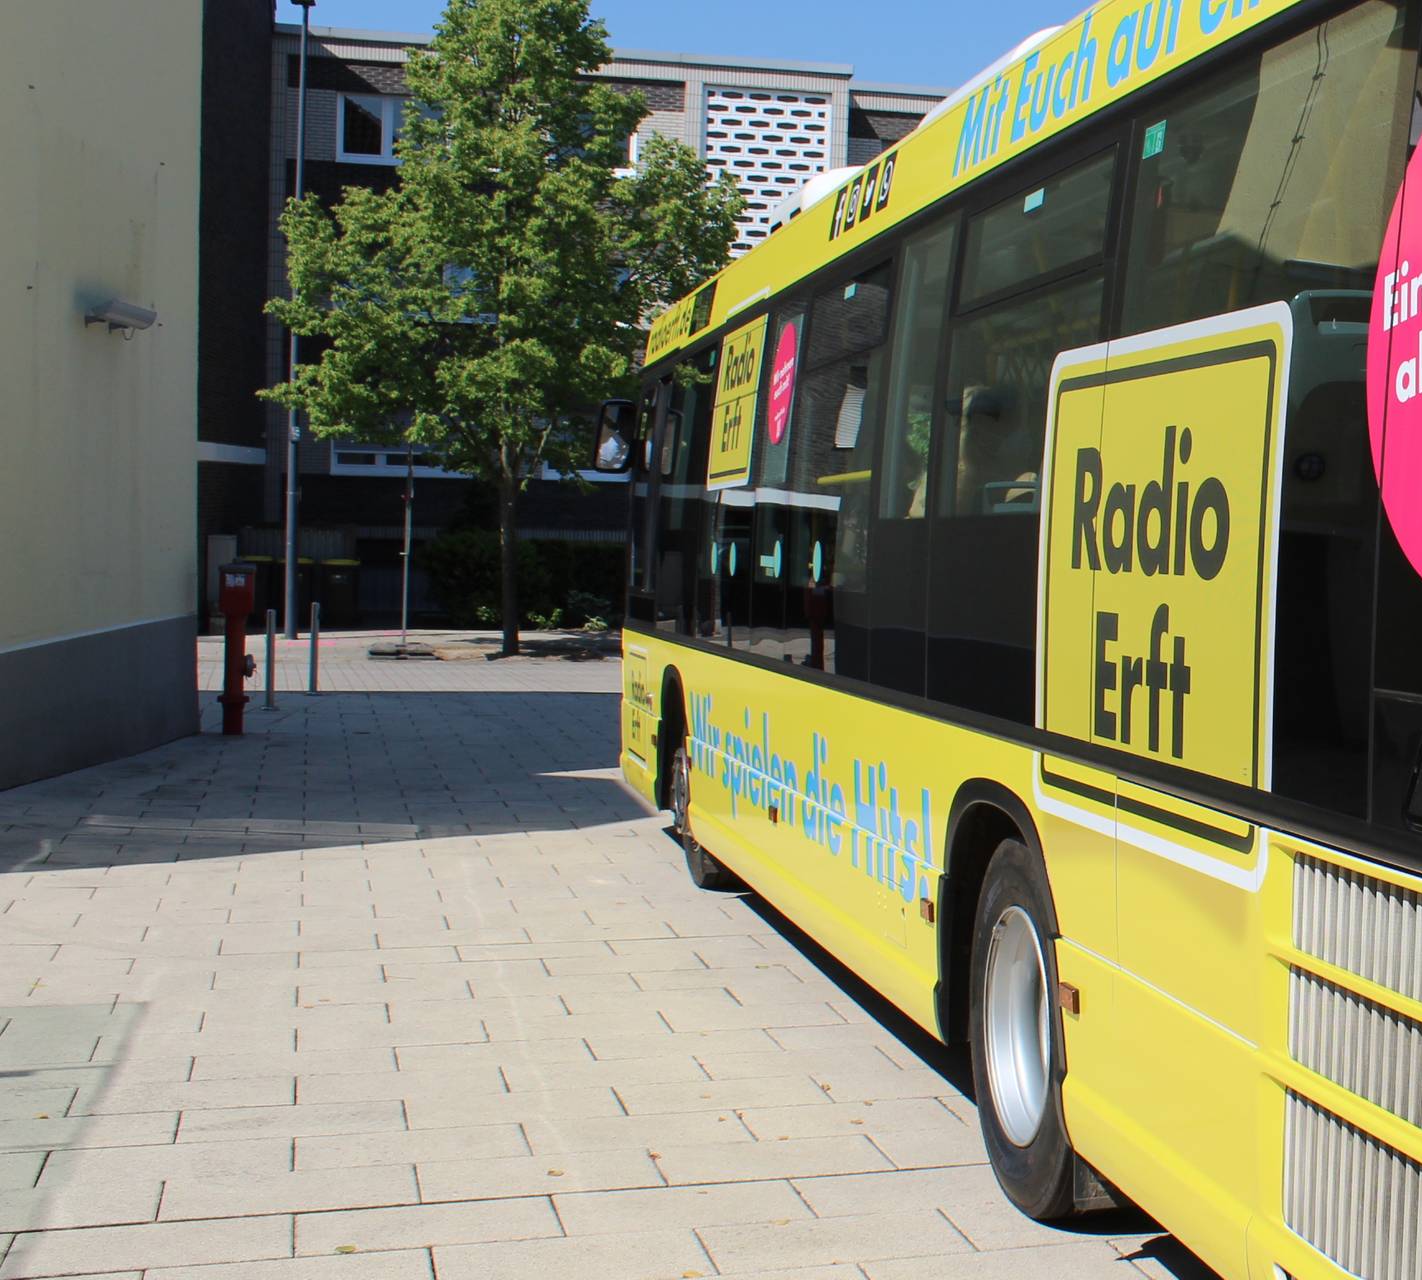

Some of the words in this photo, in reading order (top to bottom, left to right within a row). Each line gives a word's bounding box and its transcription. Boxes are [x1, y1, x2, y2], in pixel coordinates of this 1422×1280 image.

[952, 73, 1010, 177] Mit
[1010, 8, 1099, 144] Euch
[721, 397, 742, 453] Erft
[723, 332, 755, 392] Radio
[1071, 425, 1230, 581] Radio
[1094, 603, 1191, 759] Erft
[690, 690, 721, 779] Wir
[722, 706, 799, 828] spielen
[801, 732, 846, 857] die
[851, 758, 934, 903] Hits!
